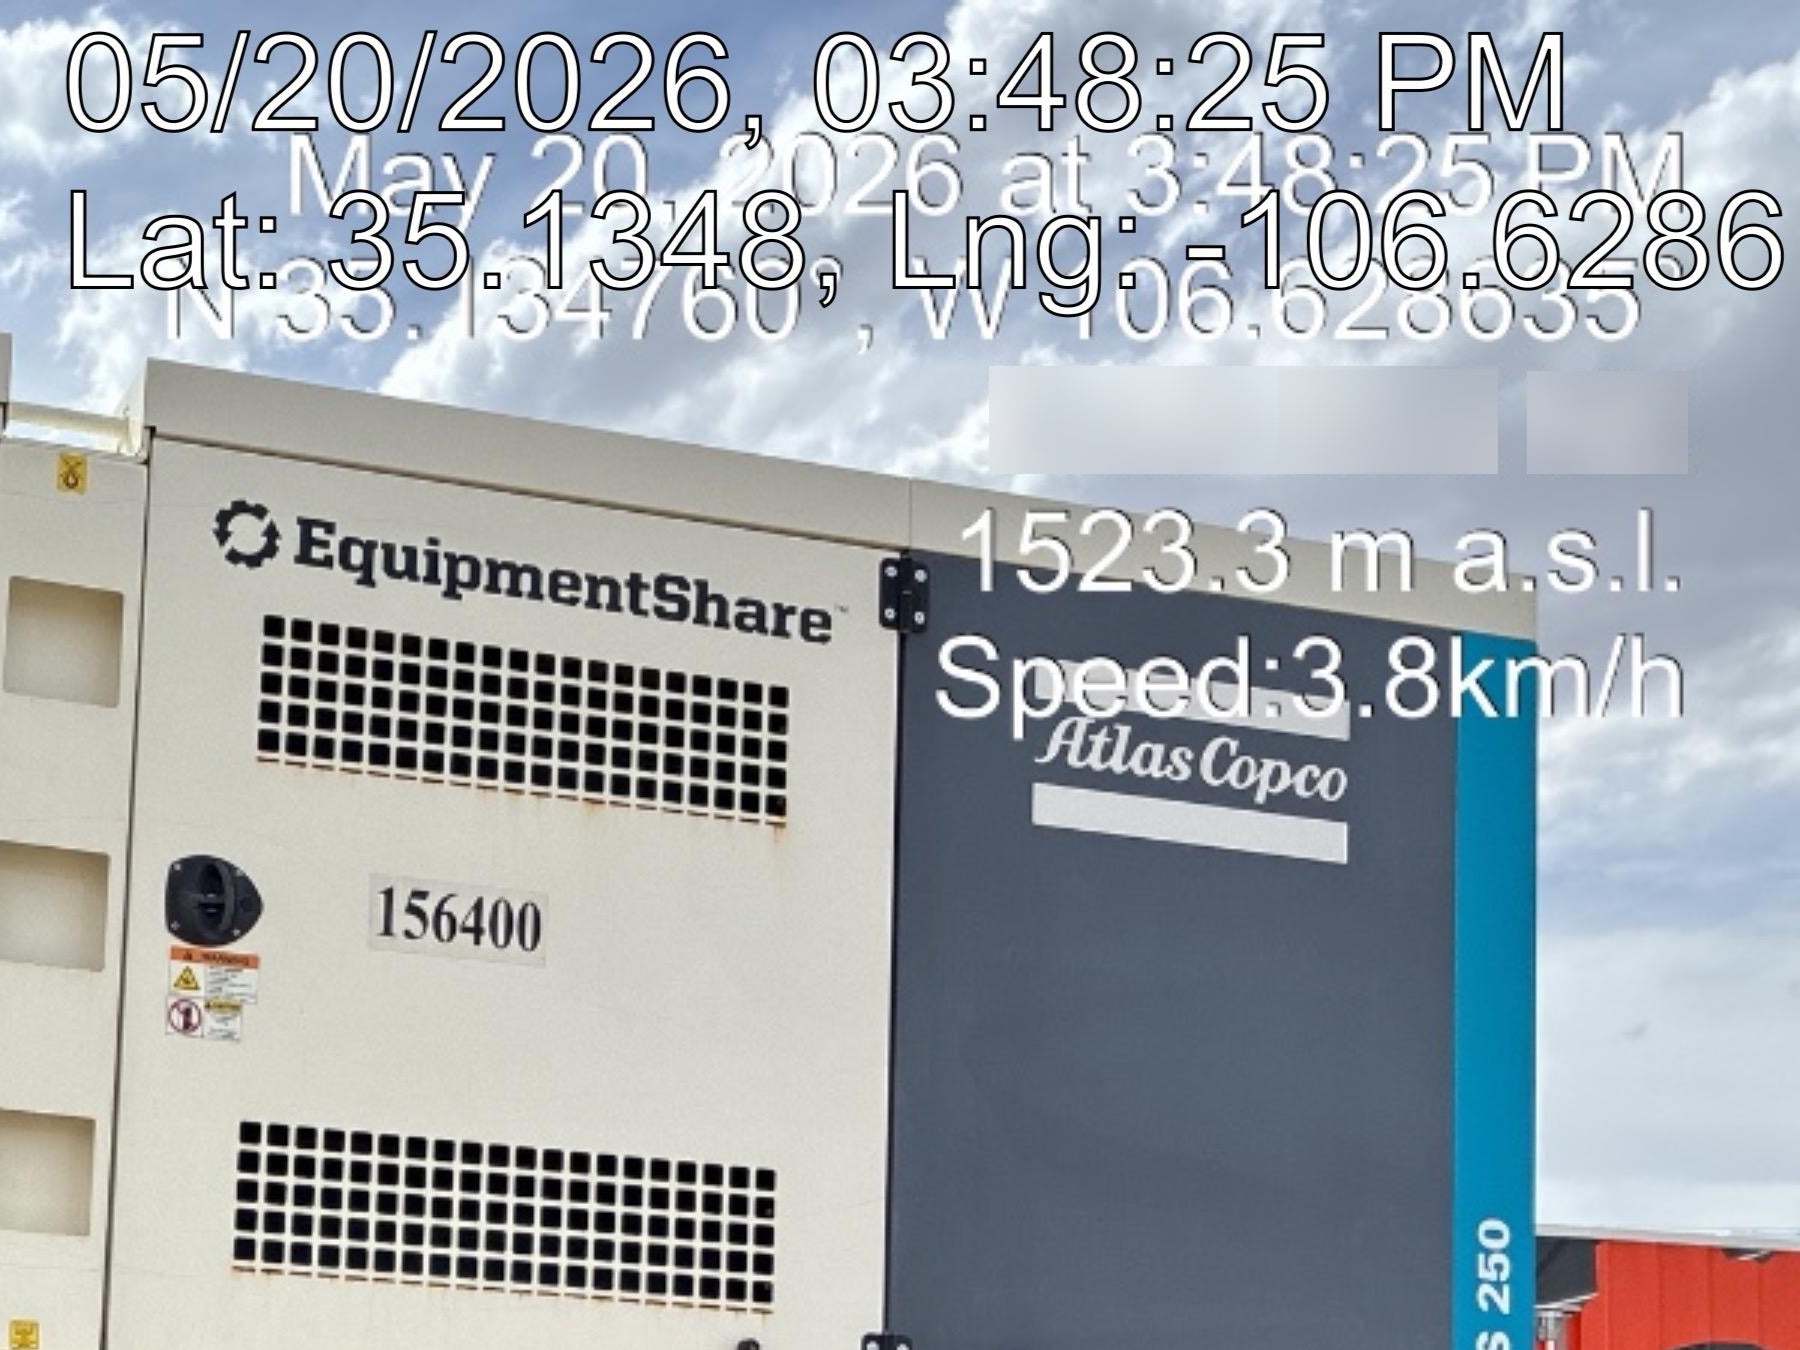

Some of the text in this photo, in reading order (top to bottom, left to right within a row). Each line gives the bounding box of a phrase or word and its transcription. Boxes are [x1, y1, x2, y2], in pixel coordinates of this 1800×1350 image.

[293, 516, 832, 644] EquipmentShare
[1034, 715, 1348, 805] Atlas Copco
[376, 885, 542, 953] 156400
[1476, 1218, 1511, 1315] 250
